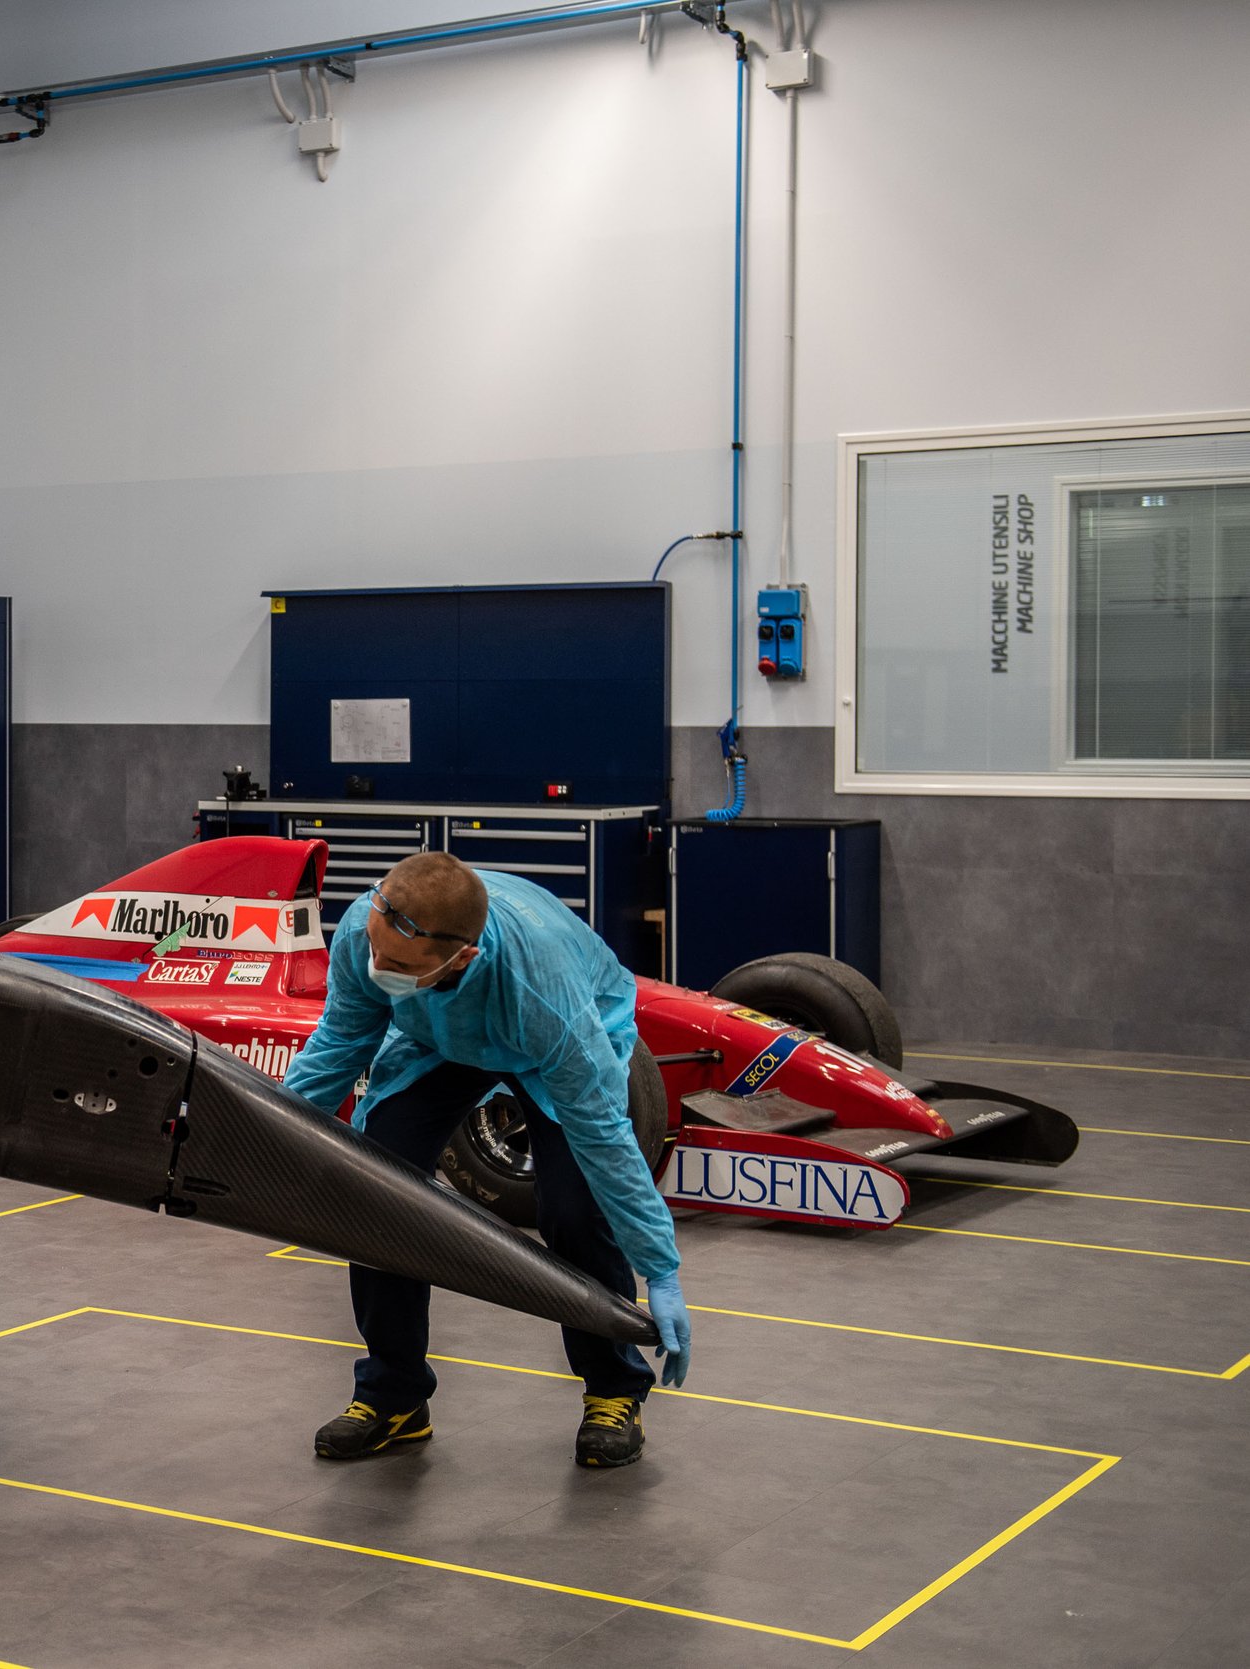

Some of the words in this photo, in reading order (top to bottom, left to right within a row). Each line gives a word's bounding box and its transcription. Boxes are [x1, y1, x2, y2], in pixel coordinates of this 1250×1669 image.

[992, 494, 1010, 575] UTENSILI
[1017, 494, 1034, 545] SHOP
[992, 580, 1009, 674] MACCHINE
[1016, 550, 1034, 634] MACHINE
[111, 899, 229, 940] Marlboro
[744, 1052, 780, 1087] SECOL
[674, 1149, 890, 1219] LUSFINA
